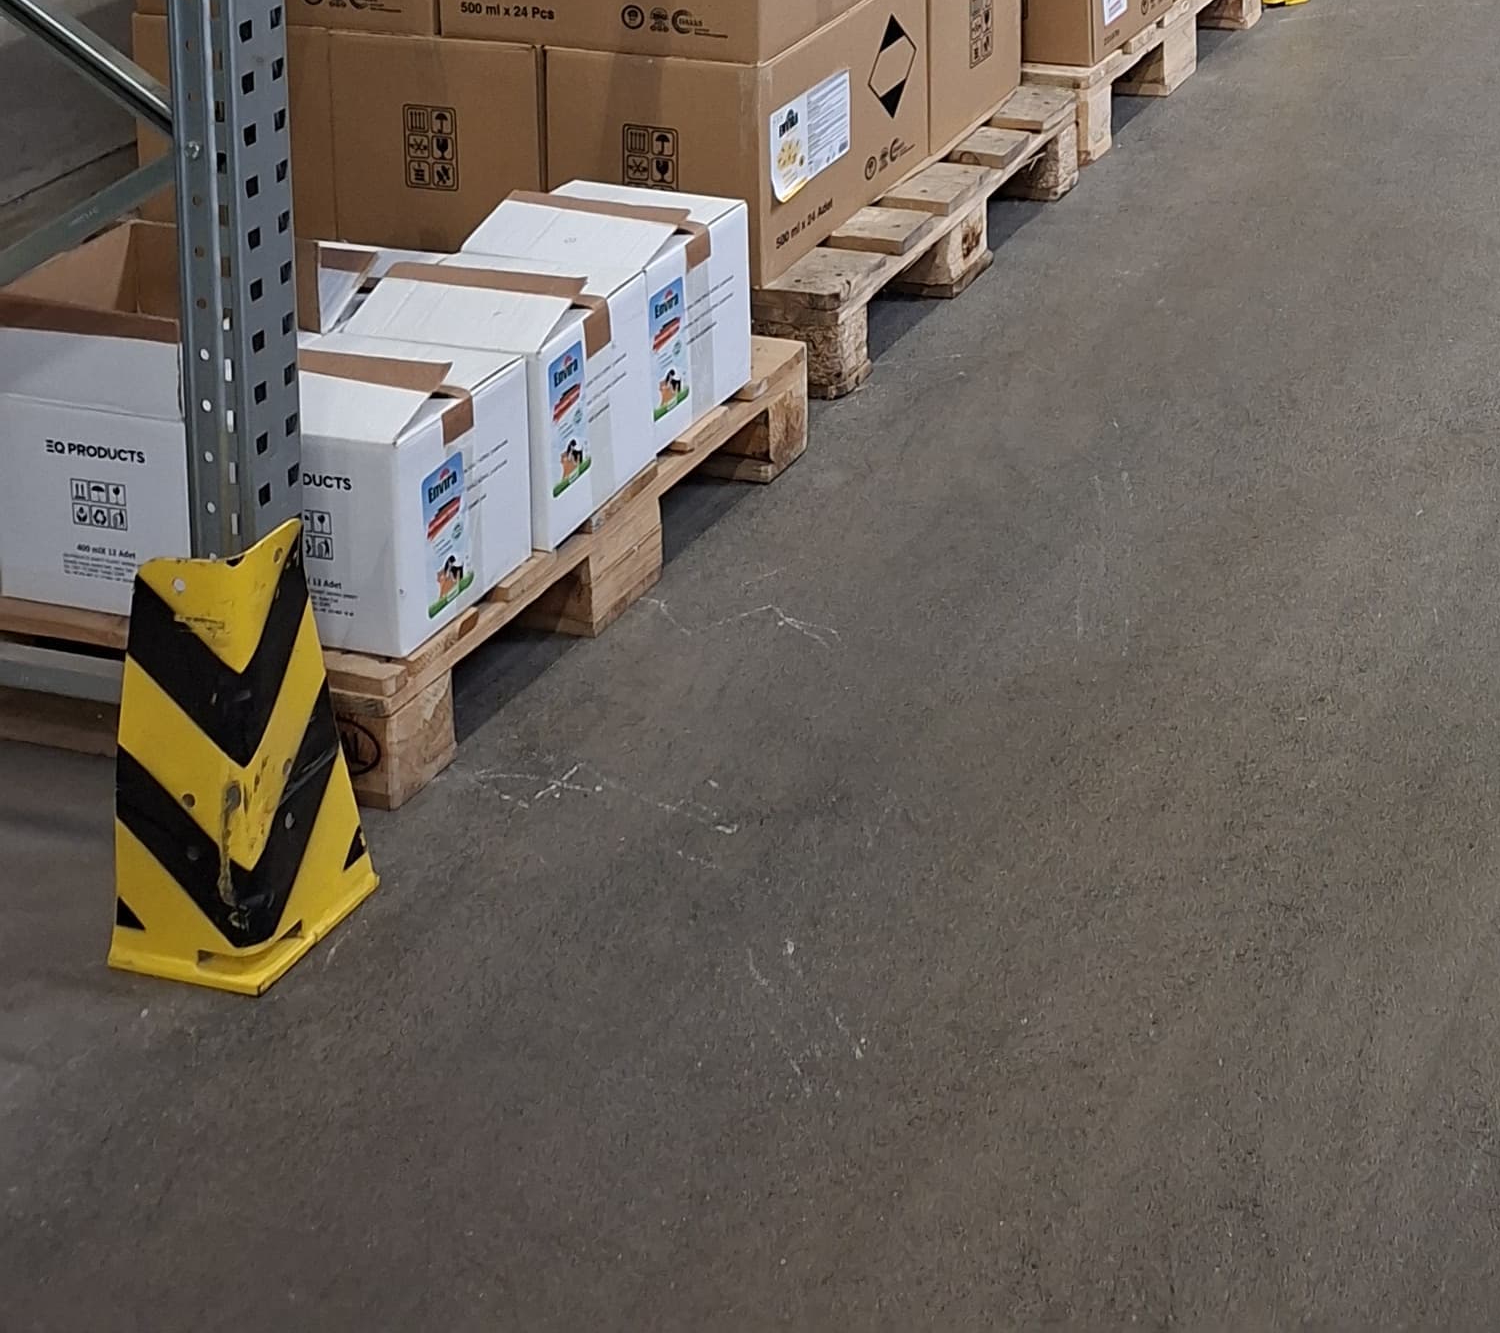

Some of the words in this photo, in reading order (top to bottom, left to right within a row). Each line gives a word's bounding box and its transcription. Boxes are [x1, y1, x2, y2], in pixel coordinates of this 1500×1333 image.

[461, 2, 482, 14] 500
[486, 4, 500, 16] ml
[504, 8, 511, 17] x
[513, 6, 528, 18] 24
[531, 7, 555, 20] Pcs
[45, 439, 65, 454] EQ
[68, 442, 145, 463] PRODUCTS
[303, 473, 352, 491] DUCTS
[428, 470, 458, 504] Envira
